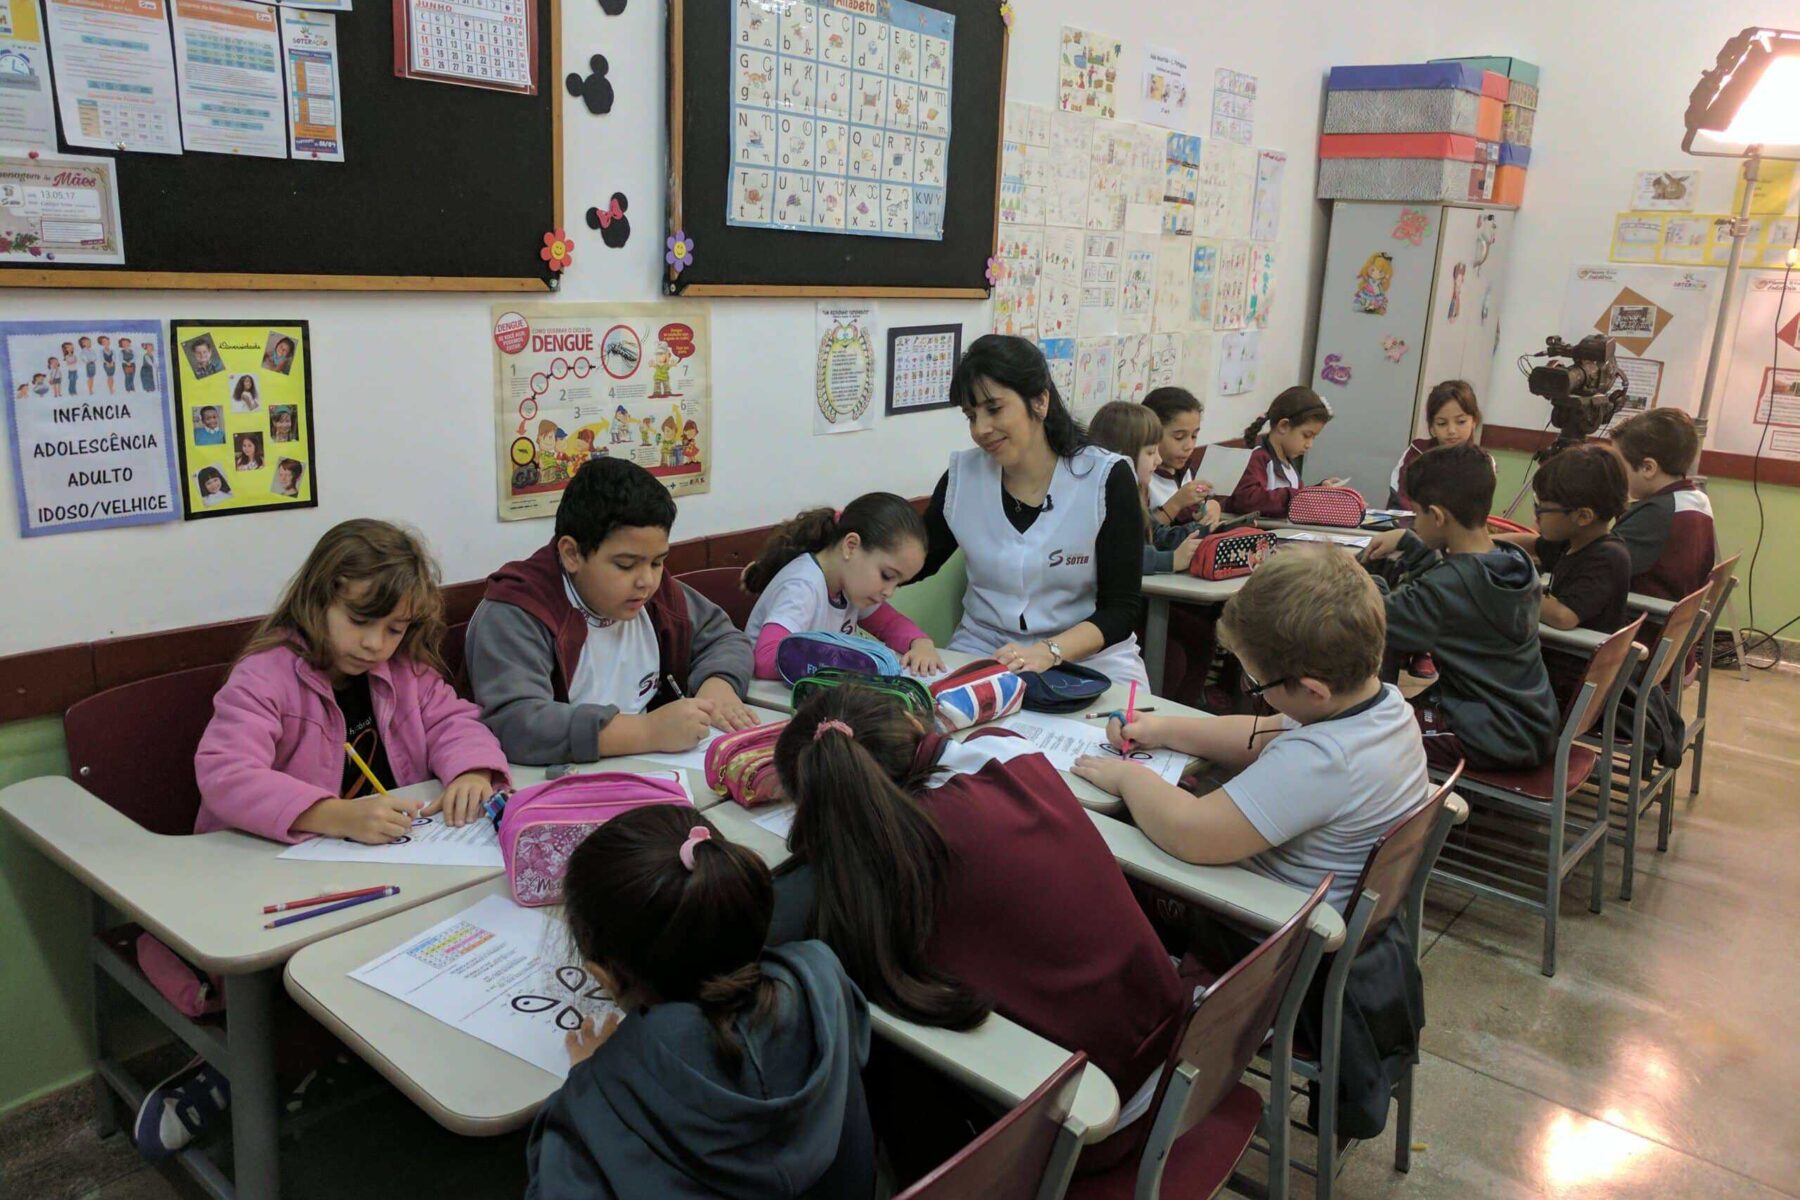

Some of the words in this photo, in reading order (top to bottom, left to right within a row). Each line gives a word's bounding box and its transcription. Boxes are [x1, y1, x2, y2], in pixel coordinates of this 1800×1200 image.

[416, 0, 452, 12] JUNHO
[785, 5, 792, 18] B
[824, 14, 830, 27] C
[858, 22, 866, 35] D
[896, 31, 900, 44] E
[926, 40, 930, 52] F
[740, 54, 749, 68] G
[784, 62, 792, 76] H
[920, 90, 928, 104] M
[740, 113, 747, 126] N
[782, 119, 790, 132] O
[822, 125, 827, 138] P
[853, 132, 861, 146] Q
[888, 136, 894, 148] R
[920, 141, 925, 153] S
[52, 172, 97, 187] Mães
[741, 172, 748, 186] T
[779, 176, 786, 190] U
[817, 180, 824, 193] V
[850, 184, 856, 197] X
[886, 188, 892, 200] Z
[532, 334, 593, 352] DENGUE
[511, 364, 517, 376] 1
[682, 366, 689, 376] 7
[560, 390, 567, 401] 2
[608, 388, 616, 399] 4
[681, 400, 687, 411] 6
[53, 402, 131, 424] INFÂNCIA
[574, 407, 581, 419] 3
[33, 432, 157, 459] ADOLESCÊNCIA
[630, 450, 636, 460] 5
[67, 466, 133, 488] ADULTO
[38, 494, 168, 524] IDOSO/VELHICE
[1065, 555, 1089, 565] SOTER
